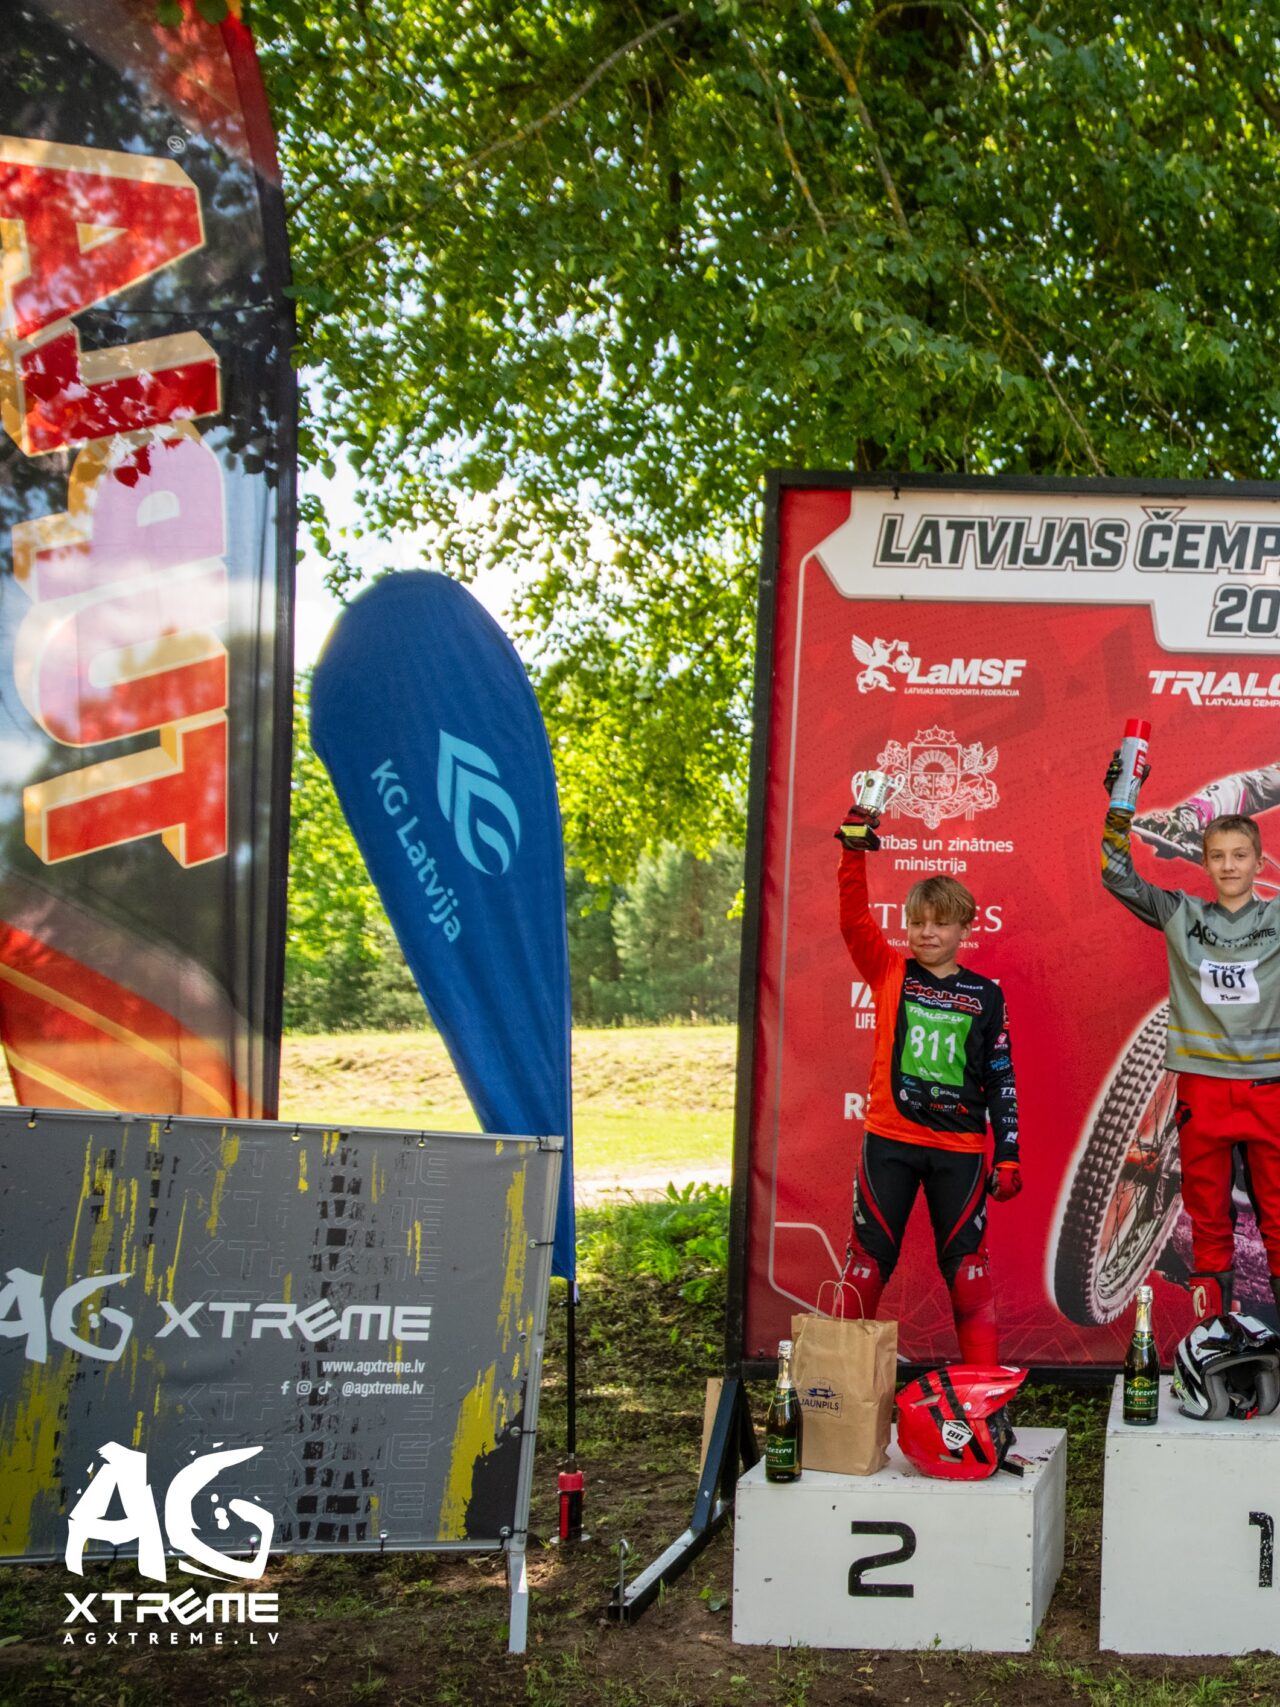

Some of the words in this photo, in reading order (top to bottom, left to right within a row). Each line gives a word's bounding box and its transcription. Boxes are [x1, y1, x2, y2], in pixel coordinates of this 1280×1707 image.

[873, 512, 1130, 572] LATVIJAS
[906, 656, 1027, 686] LaMSF
[1205, 698, 1250, 707] LATVIJAS
[370, 758, 409, 817] KG
[396, 815, 462, 943] Latvija
[922, 838, 943, 851] un
[948, 836, 1014, 853] zinātnes
[894, 857, 967, 875] ministrija
[1209, 968, 1246, 988] 161
[855, 1013, 876, 1029] LIFE
[910, 1025, 957, 1065] 811
[155, 1298, 432, 1345] XTREME
[322, 1357, 426, 1376] www.agxtreme.lv
[342, 1379, 425, 1398] @agxtreme.lv
[848, 1520, 917, 1598] 2
[1248, 1511, 1275, 1588] 1
